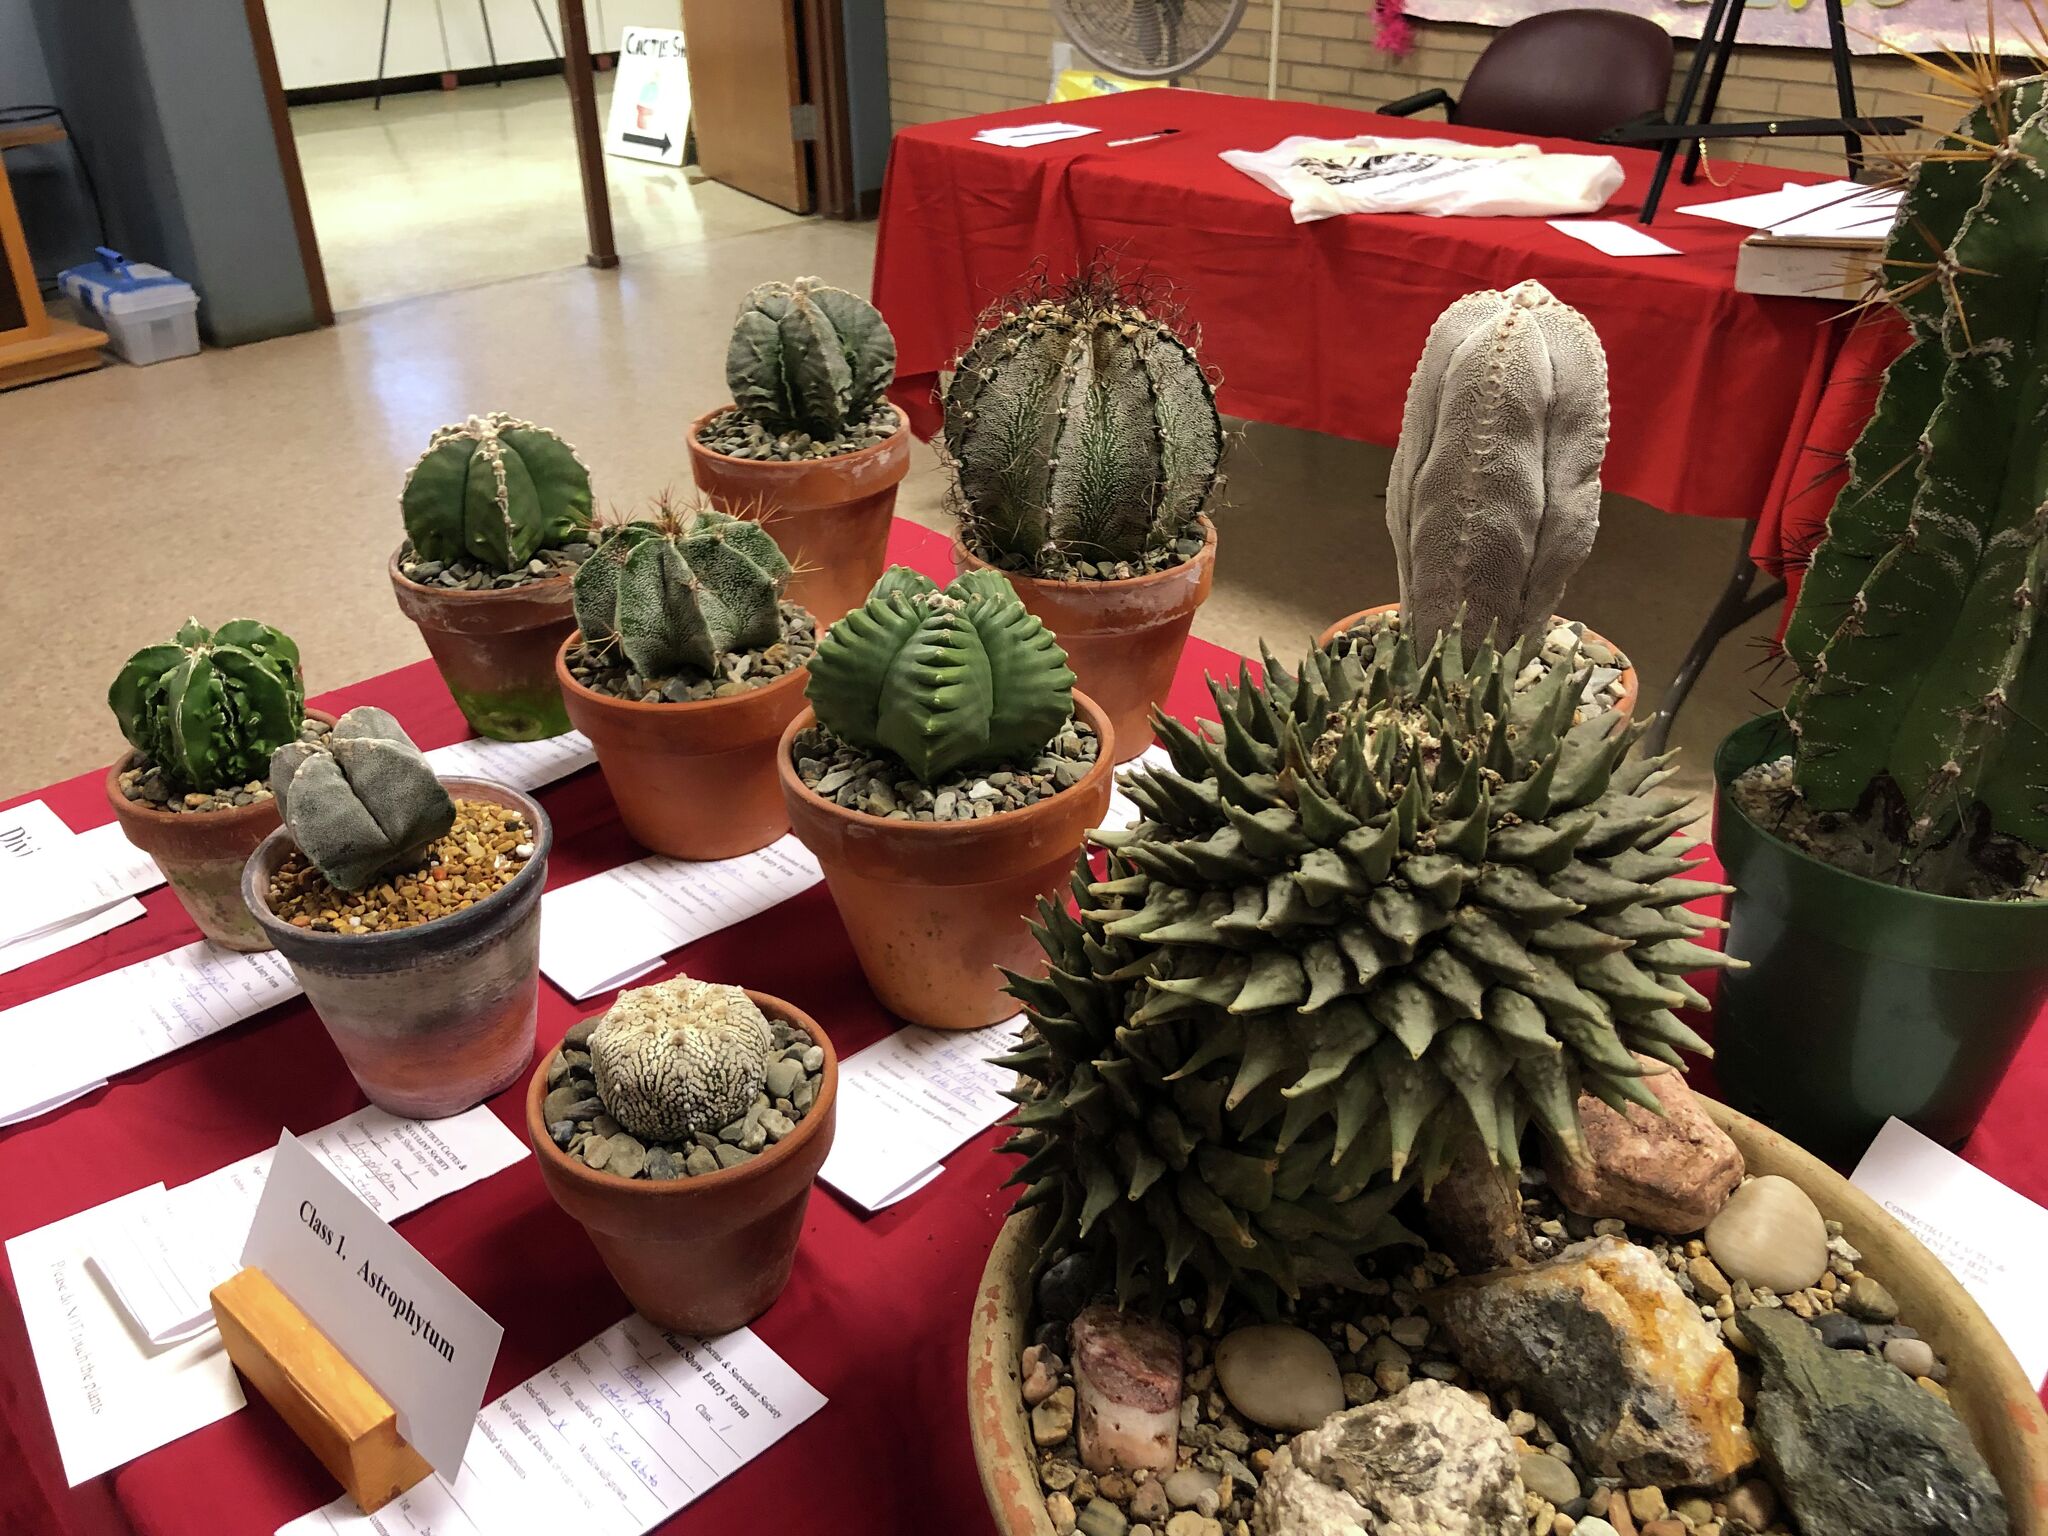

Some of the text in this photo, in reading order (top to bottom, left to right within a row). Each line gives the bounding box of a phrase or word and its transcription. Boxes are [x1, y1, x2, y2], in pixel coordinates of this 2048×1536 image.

[299, 1200, 456, 1363] Class 1. Astrophytum
[82, 1382, 102, 1415] plants
[683, 1349, 704, 1373] Show
[702, 1370, 727, 1399] Entry
[725, 1393, 750, 1420] Form
[721, 1360, 732, 1369] &
[729, 1367, 760, 1399] Succulent
[758, 1391, 783, 1420] Society
